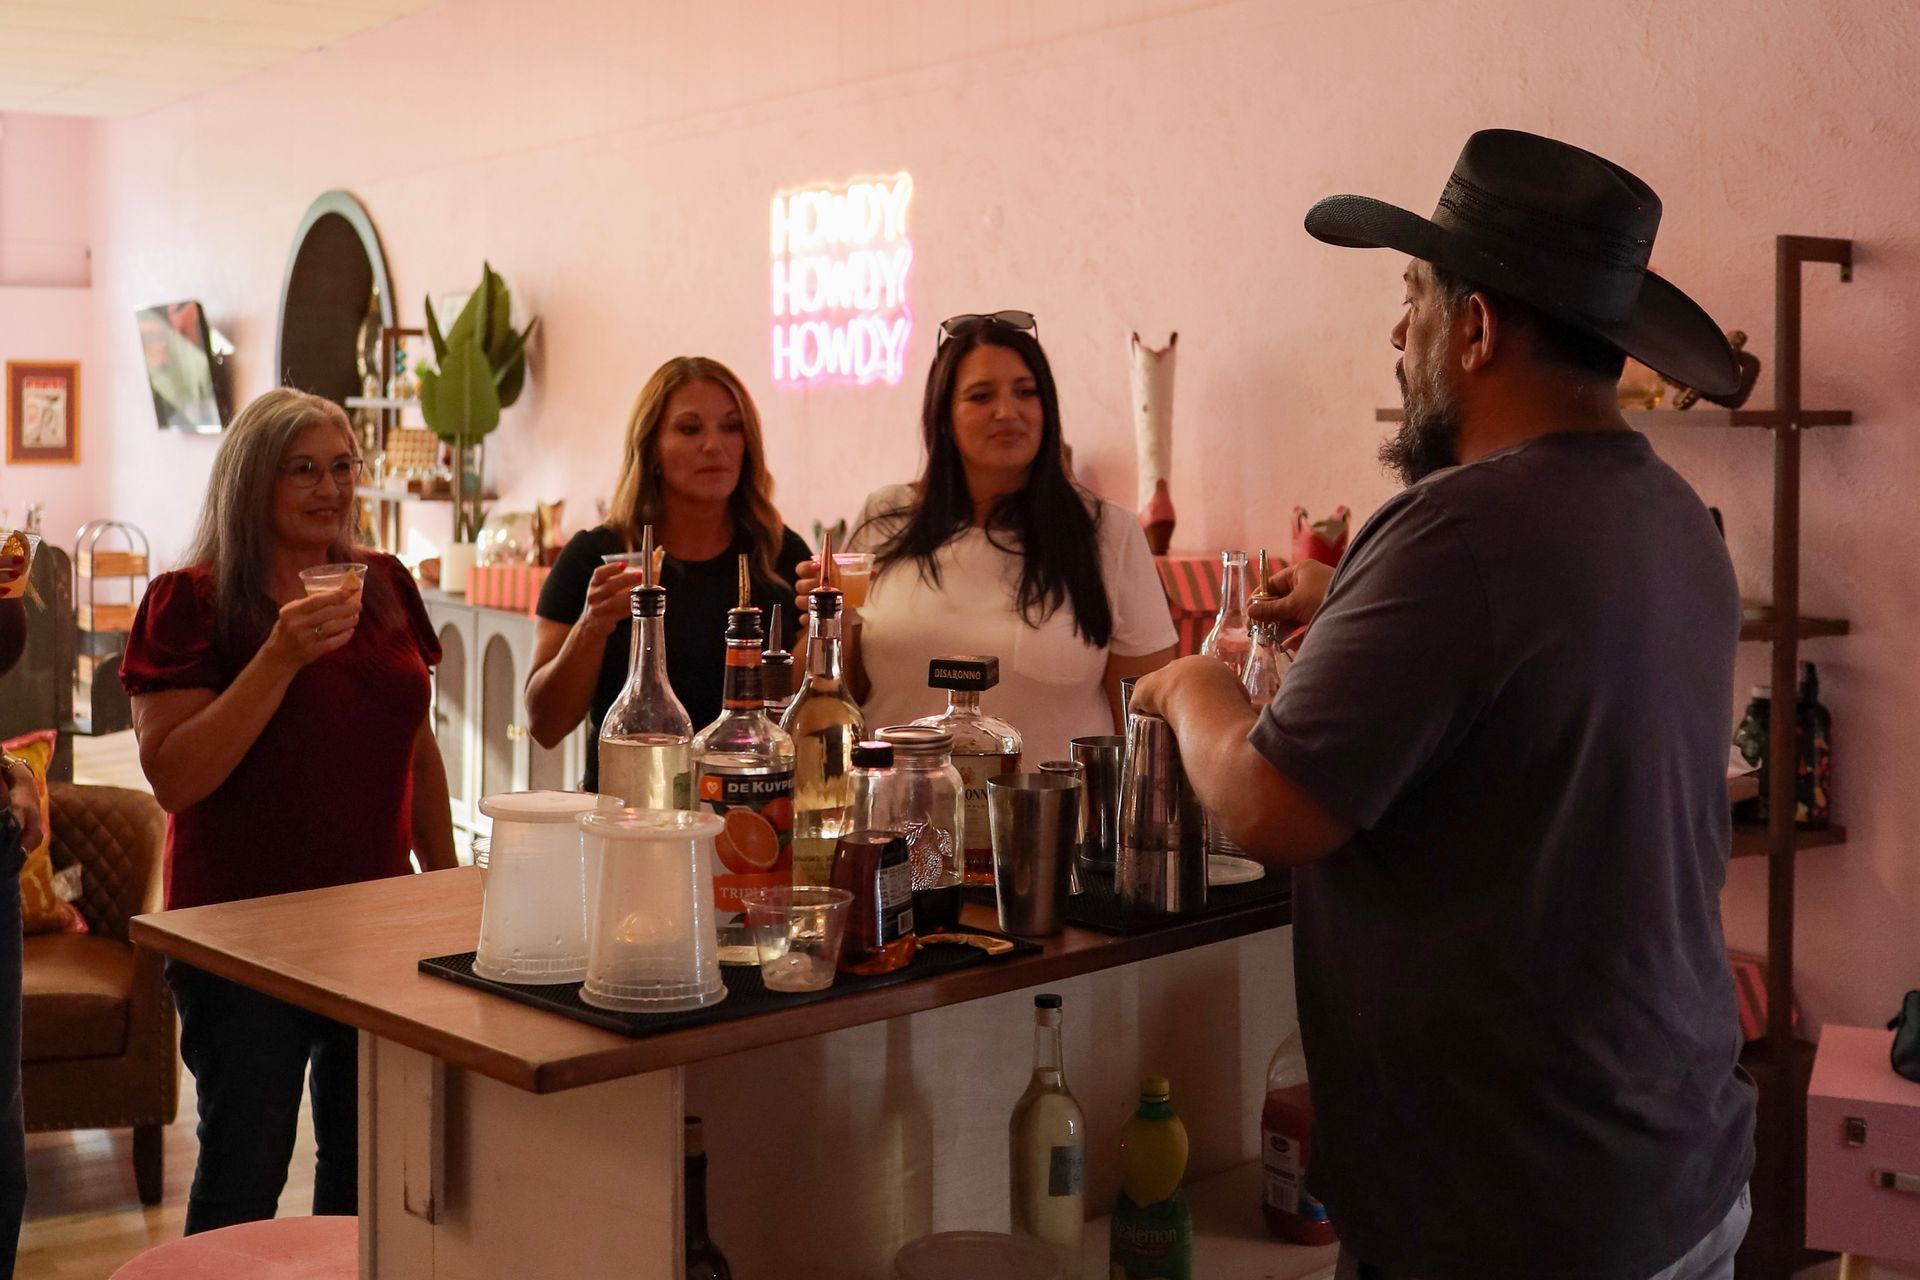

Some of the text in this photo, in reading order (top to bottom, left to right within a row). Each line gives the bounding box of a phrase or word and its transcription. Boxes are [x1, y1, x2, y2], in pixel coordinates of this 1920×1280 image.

[771, 172, 912, 257] HOWDY
[772, 245, 911, 316] HOWDY
[772, 316, 908, 382] HOWDY
[934, 668, 981, 680] DISARONNO
[727, 779, 794, 794] DE KUYPE
